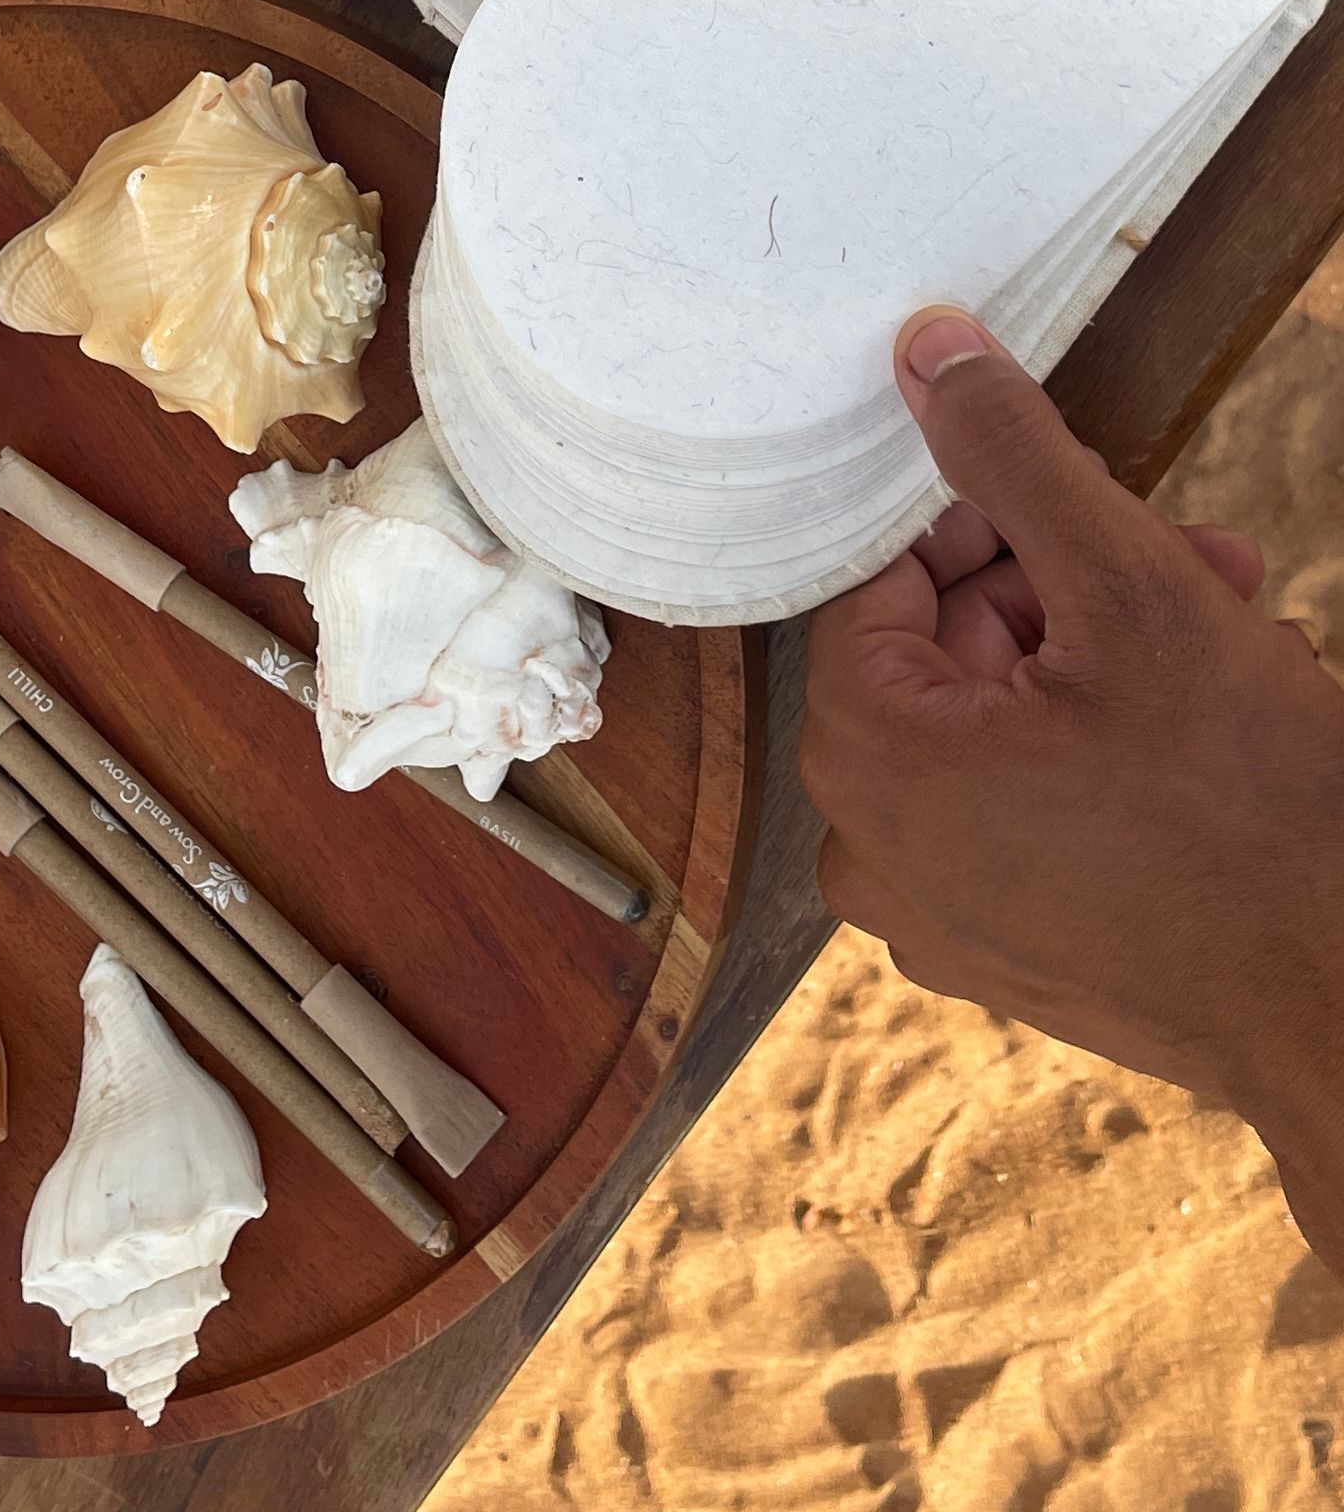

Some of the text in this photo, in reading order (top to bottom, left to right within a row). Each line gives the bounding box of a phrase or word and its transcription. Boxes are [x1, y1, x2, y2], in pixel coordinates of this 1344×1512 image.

[6, 666, 54, 714] CHILLI
[98, 755, 203, 866] Sow and Grow
[479, 815, 522, 853] BASIL
